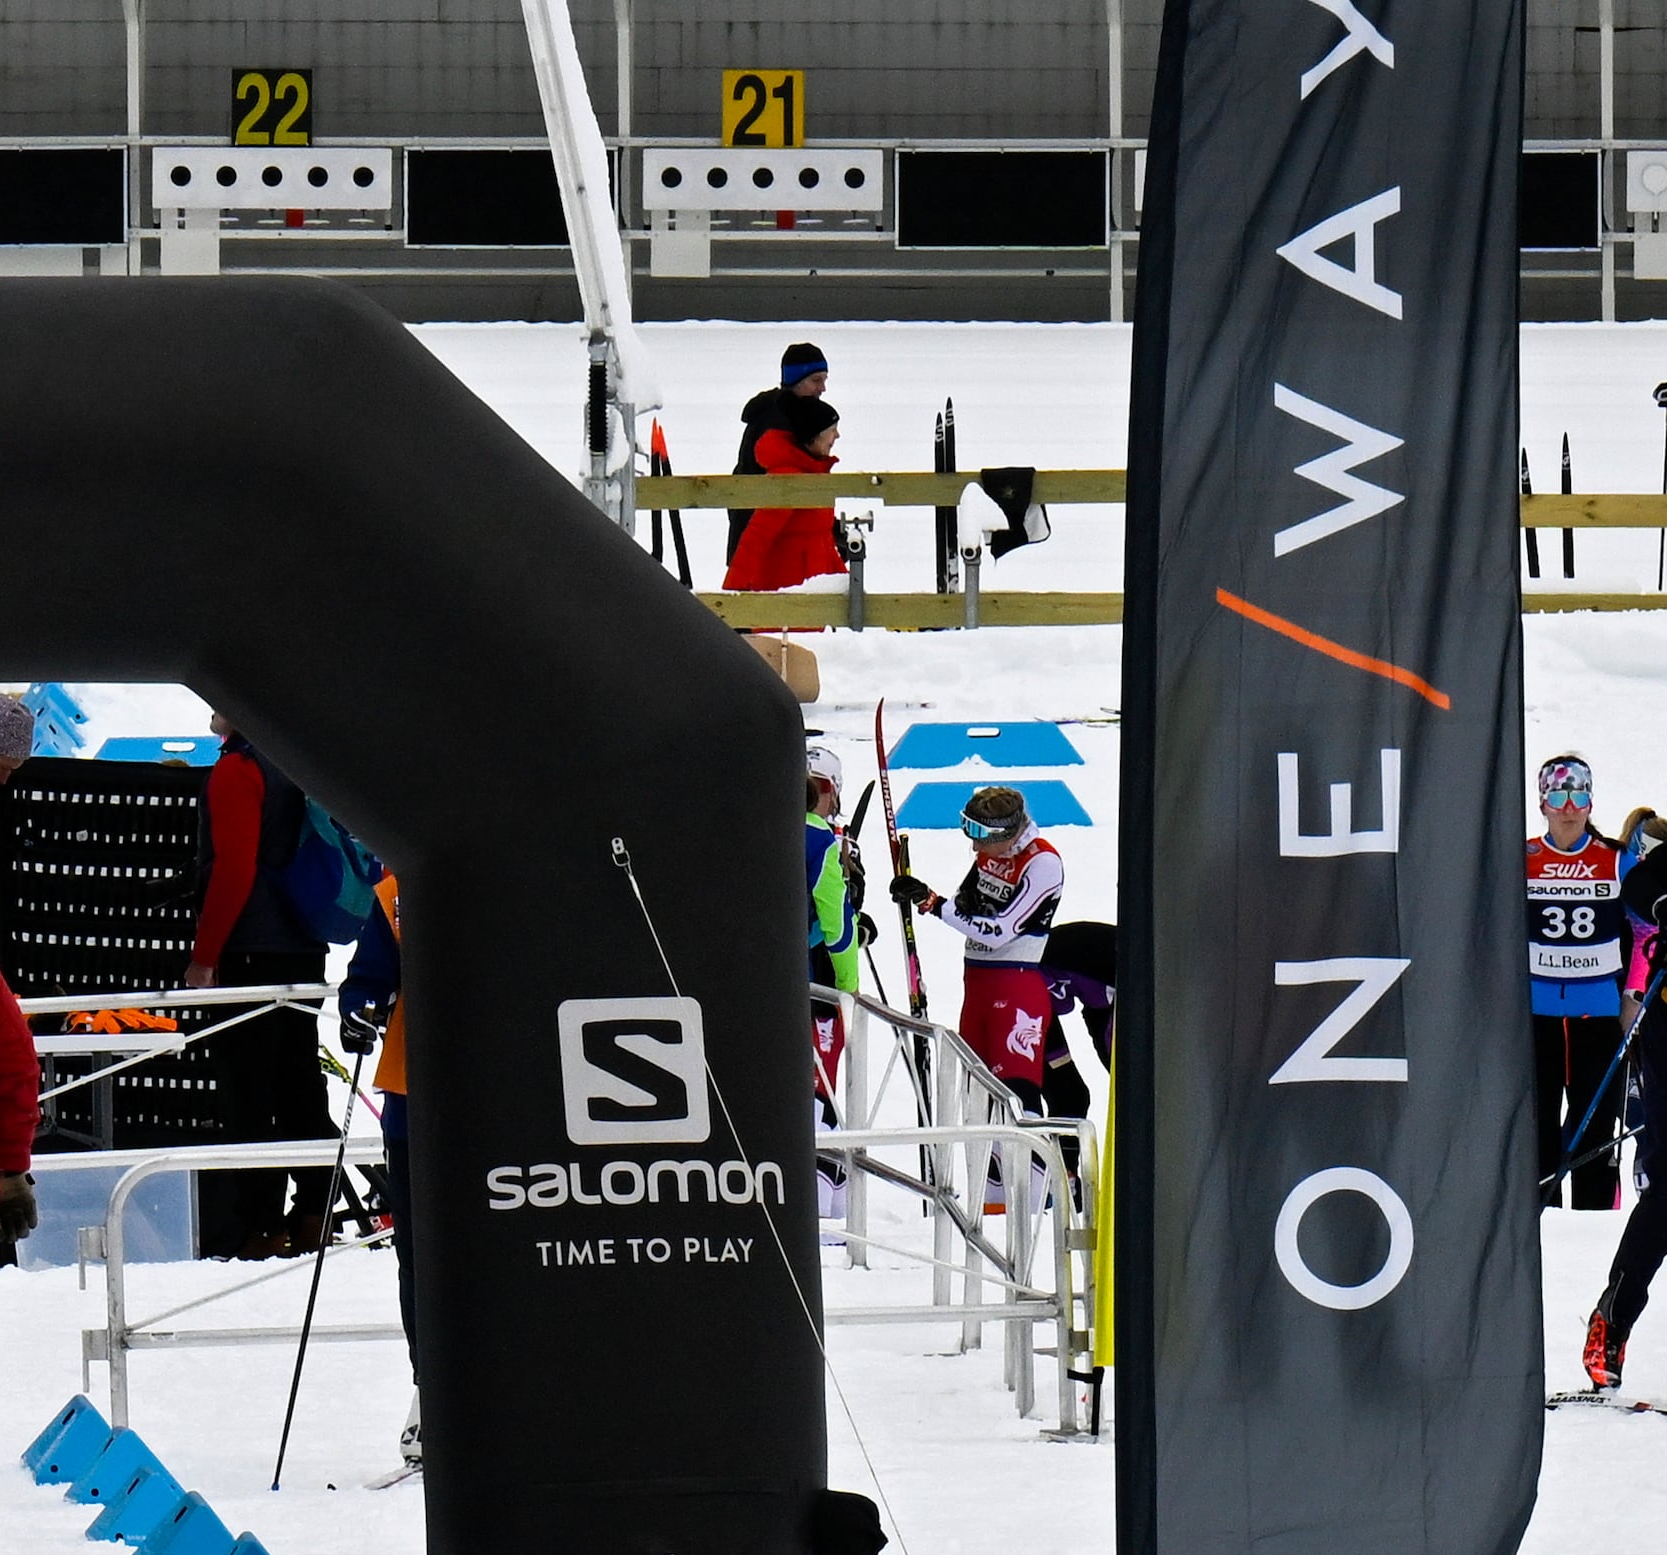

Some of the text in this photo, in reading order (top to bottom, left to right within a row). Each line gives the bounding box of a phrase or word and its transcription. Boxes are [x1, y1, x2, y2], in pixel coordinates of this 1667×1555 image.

[235, 74, 309, 145] 22
[732, 75, 794, 145] 21
[880, 768, 898, 842] MADSHUS
[1541, 905, 1596, 940] 38
[1537, 951, 1600, 969] L.L.Bean
[487, 1160, 785, 1211] salomon
[536, 1237, 754, 1266] TIME TO PLAY
